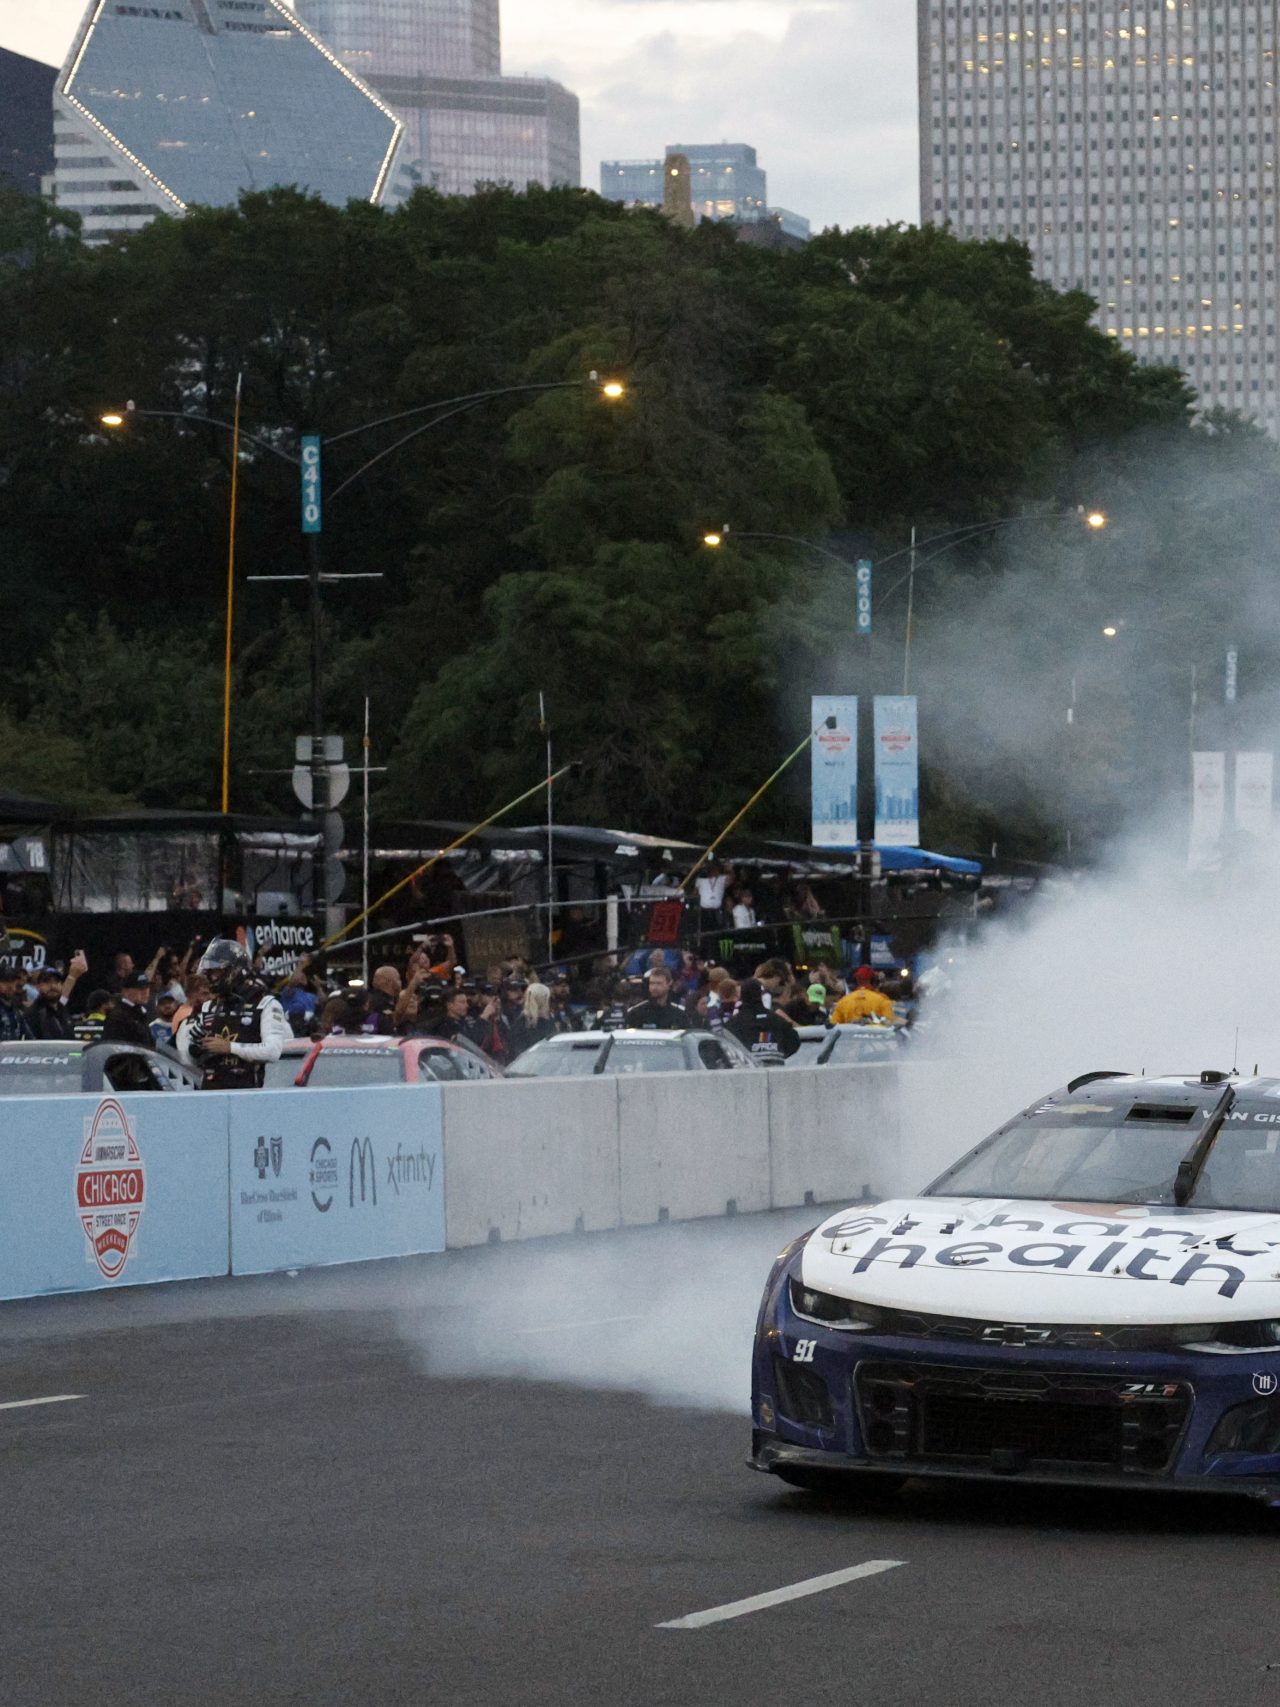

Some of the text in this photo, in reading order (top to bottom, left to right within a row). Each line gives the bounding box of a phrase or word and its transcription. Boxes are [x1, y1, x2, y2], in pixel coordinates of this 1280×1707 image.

[303, 445, 319, 522] C410
[857, 567, 871, 627] C400
[255, 919, 313, 946] enhance
[0, 1056, 69, 1065] BUSCH
[83, 1172, 138, 1204] CHICAGO
[387, 1142, 436, 1195] xfinity
[852, 1237, 1246, 1299] health
[793, 1339, 817, 1363] 91
